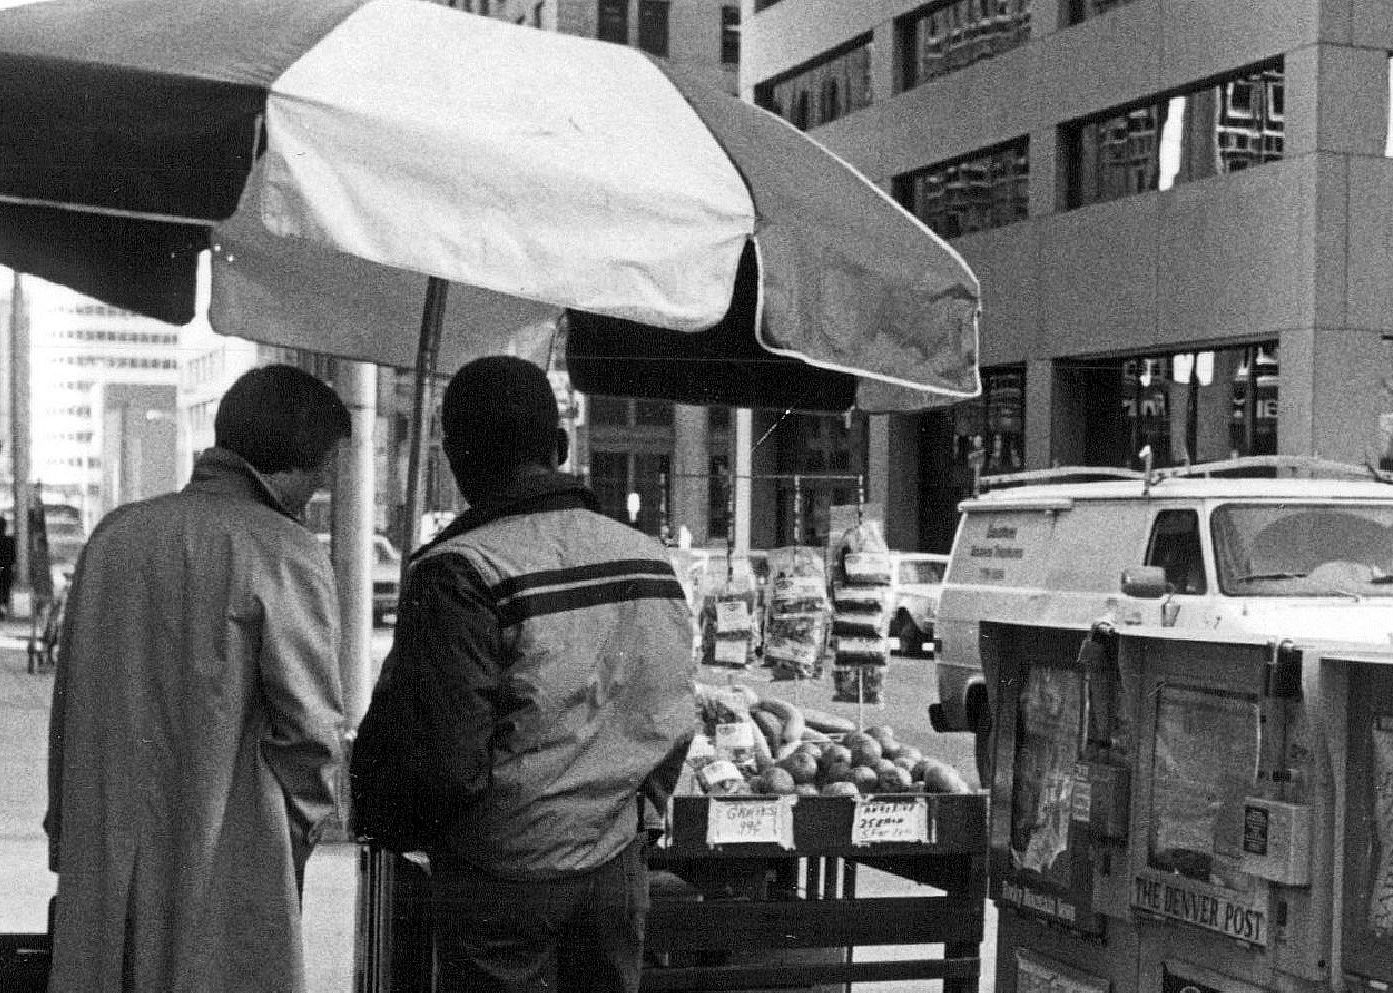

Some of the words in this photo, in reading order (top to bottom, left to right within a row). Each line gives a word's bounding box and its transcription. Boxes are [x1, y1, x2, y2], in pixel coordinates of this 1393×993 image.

[1136, 877, 1160, 909] THE
[1164, 885, 1218, 927] DENVER
[1224, 901, 1263, 940] POST
